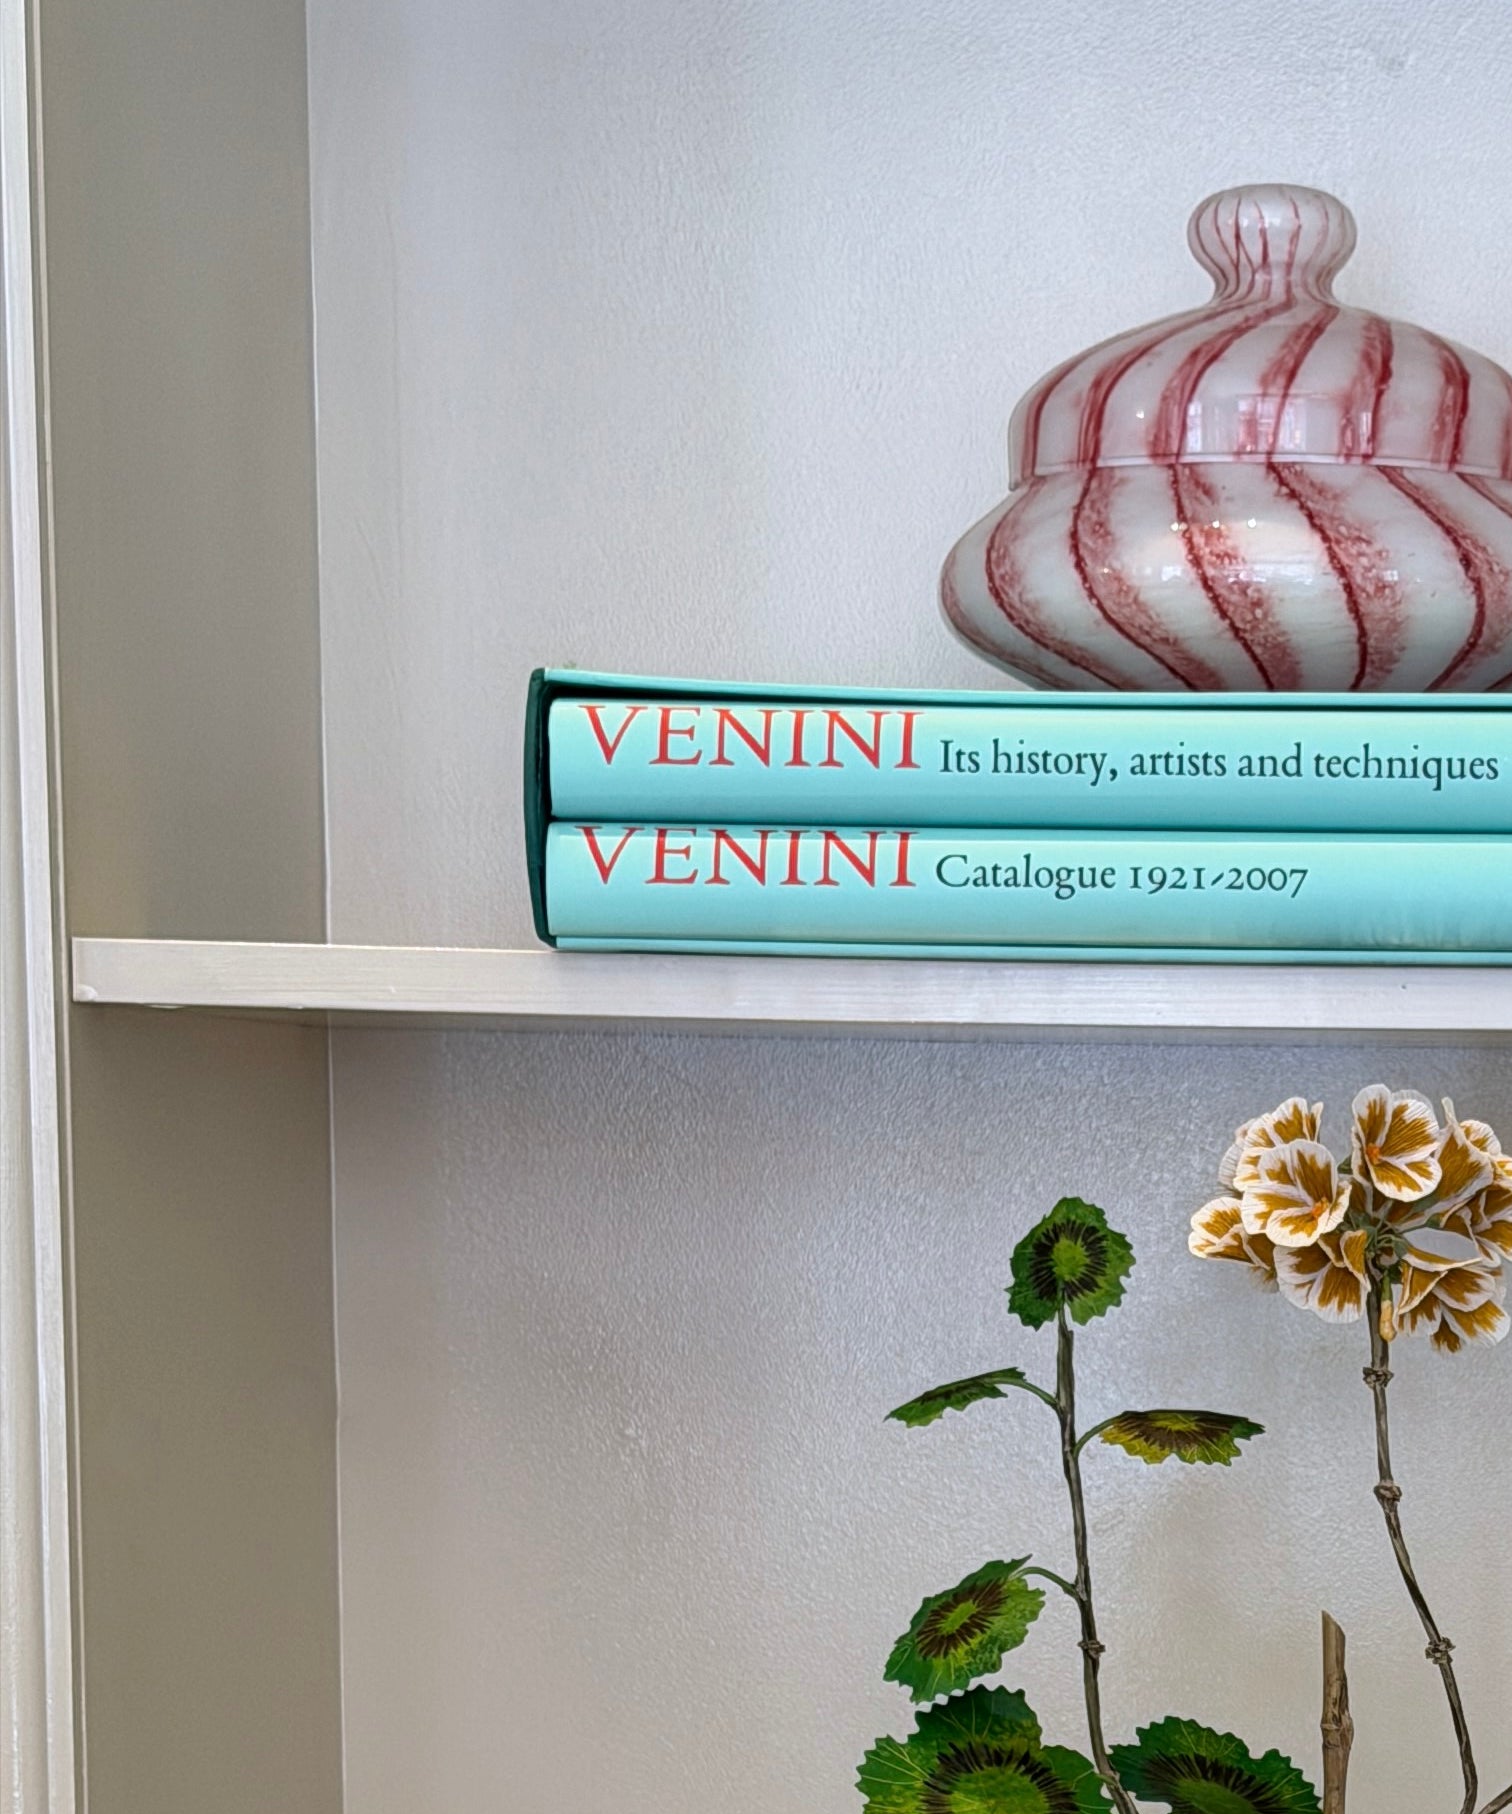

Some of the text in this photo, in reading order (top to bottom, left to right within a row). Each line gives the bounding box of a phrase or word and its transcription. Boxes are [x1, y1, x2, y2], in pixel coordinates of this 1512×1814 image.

[578, 703, 1500, 793] VENINI Its history, artists and techniques
[574, 825, 1309, 902] VENINI Catalogue 1921-2007
